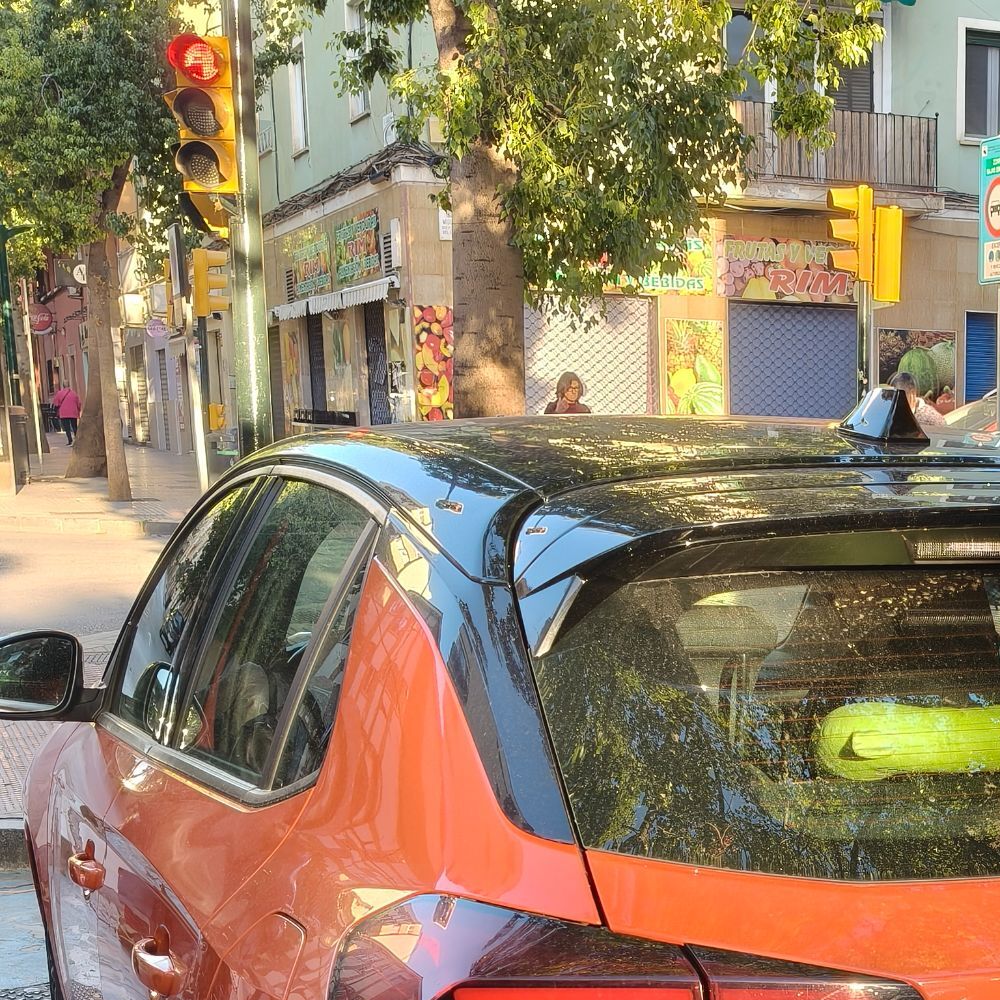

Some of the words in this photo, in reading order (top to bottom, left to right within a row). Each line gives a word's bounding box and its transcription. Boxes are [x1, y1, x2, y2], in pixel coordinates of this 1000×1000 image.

[724, 240, 786, 262] FRUTAS
[641, 275, 704, 290] BEBIDAS
[769, 269, 848, 296] RIM
